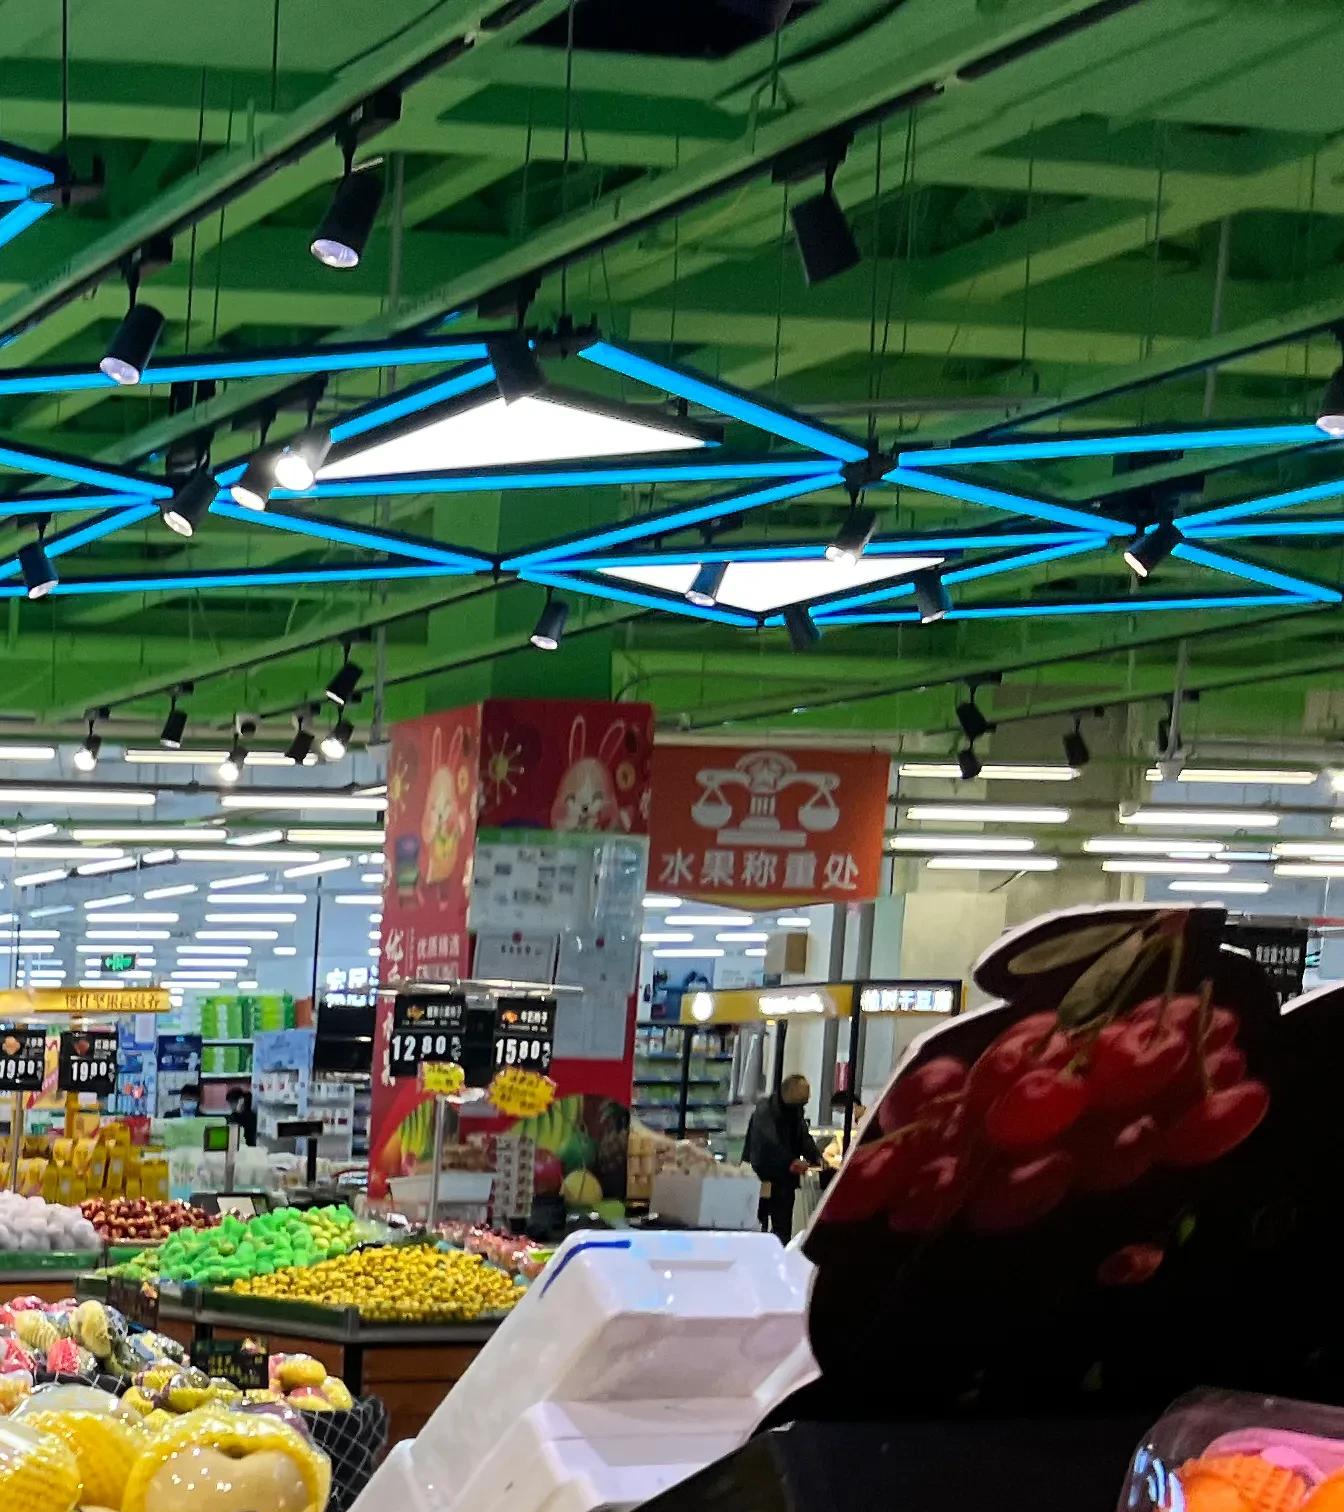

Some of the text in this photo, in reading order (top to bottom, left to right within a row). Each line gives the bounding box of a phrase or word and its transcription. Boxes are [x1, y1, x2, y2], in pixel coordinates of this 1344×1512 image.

[659, 848, 859, 890] 水果称重处
